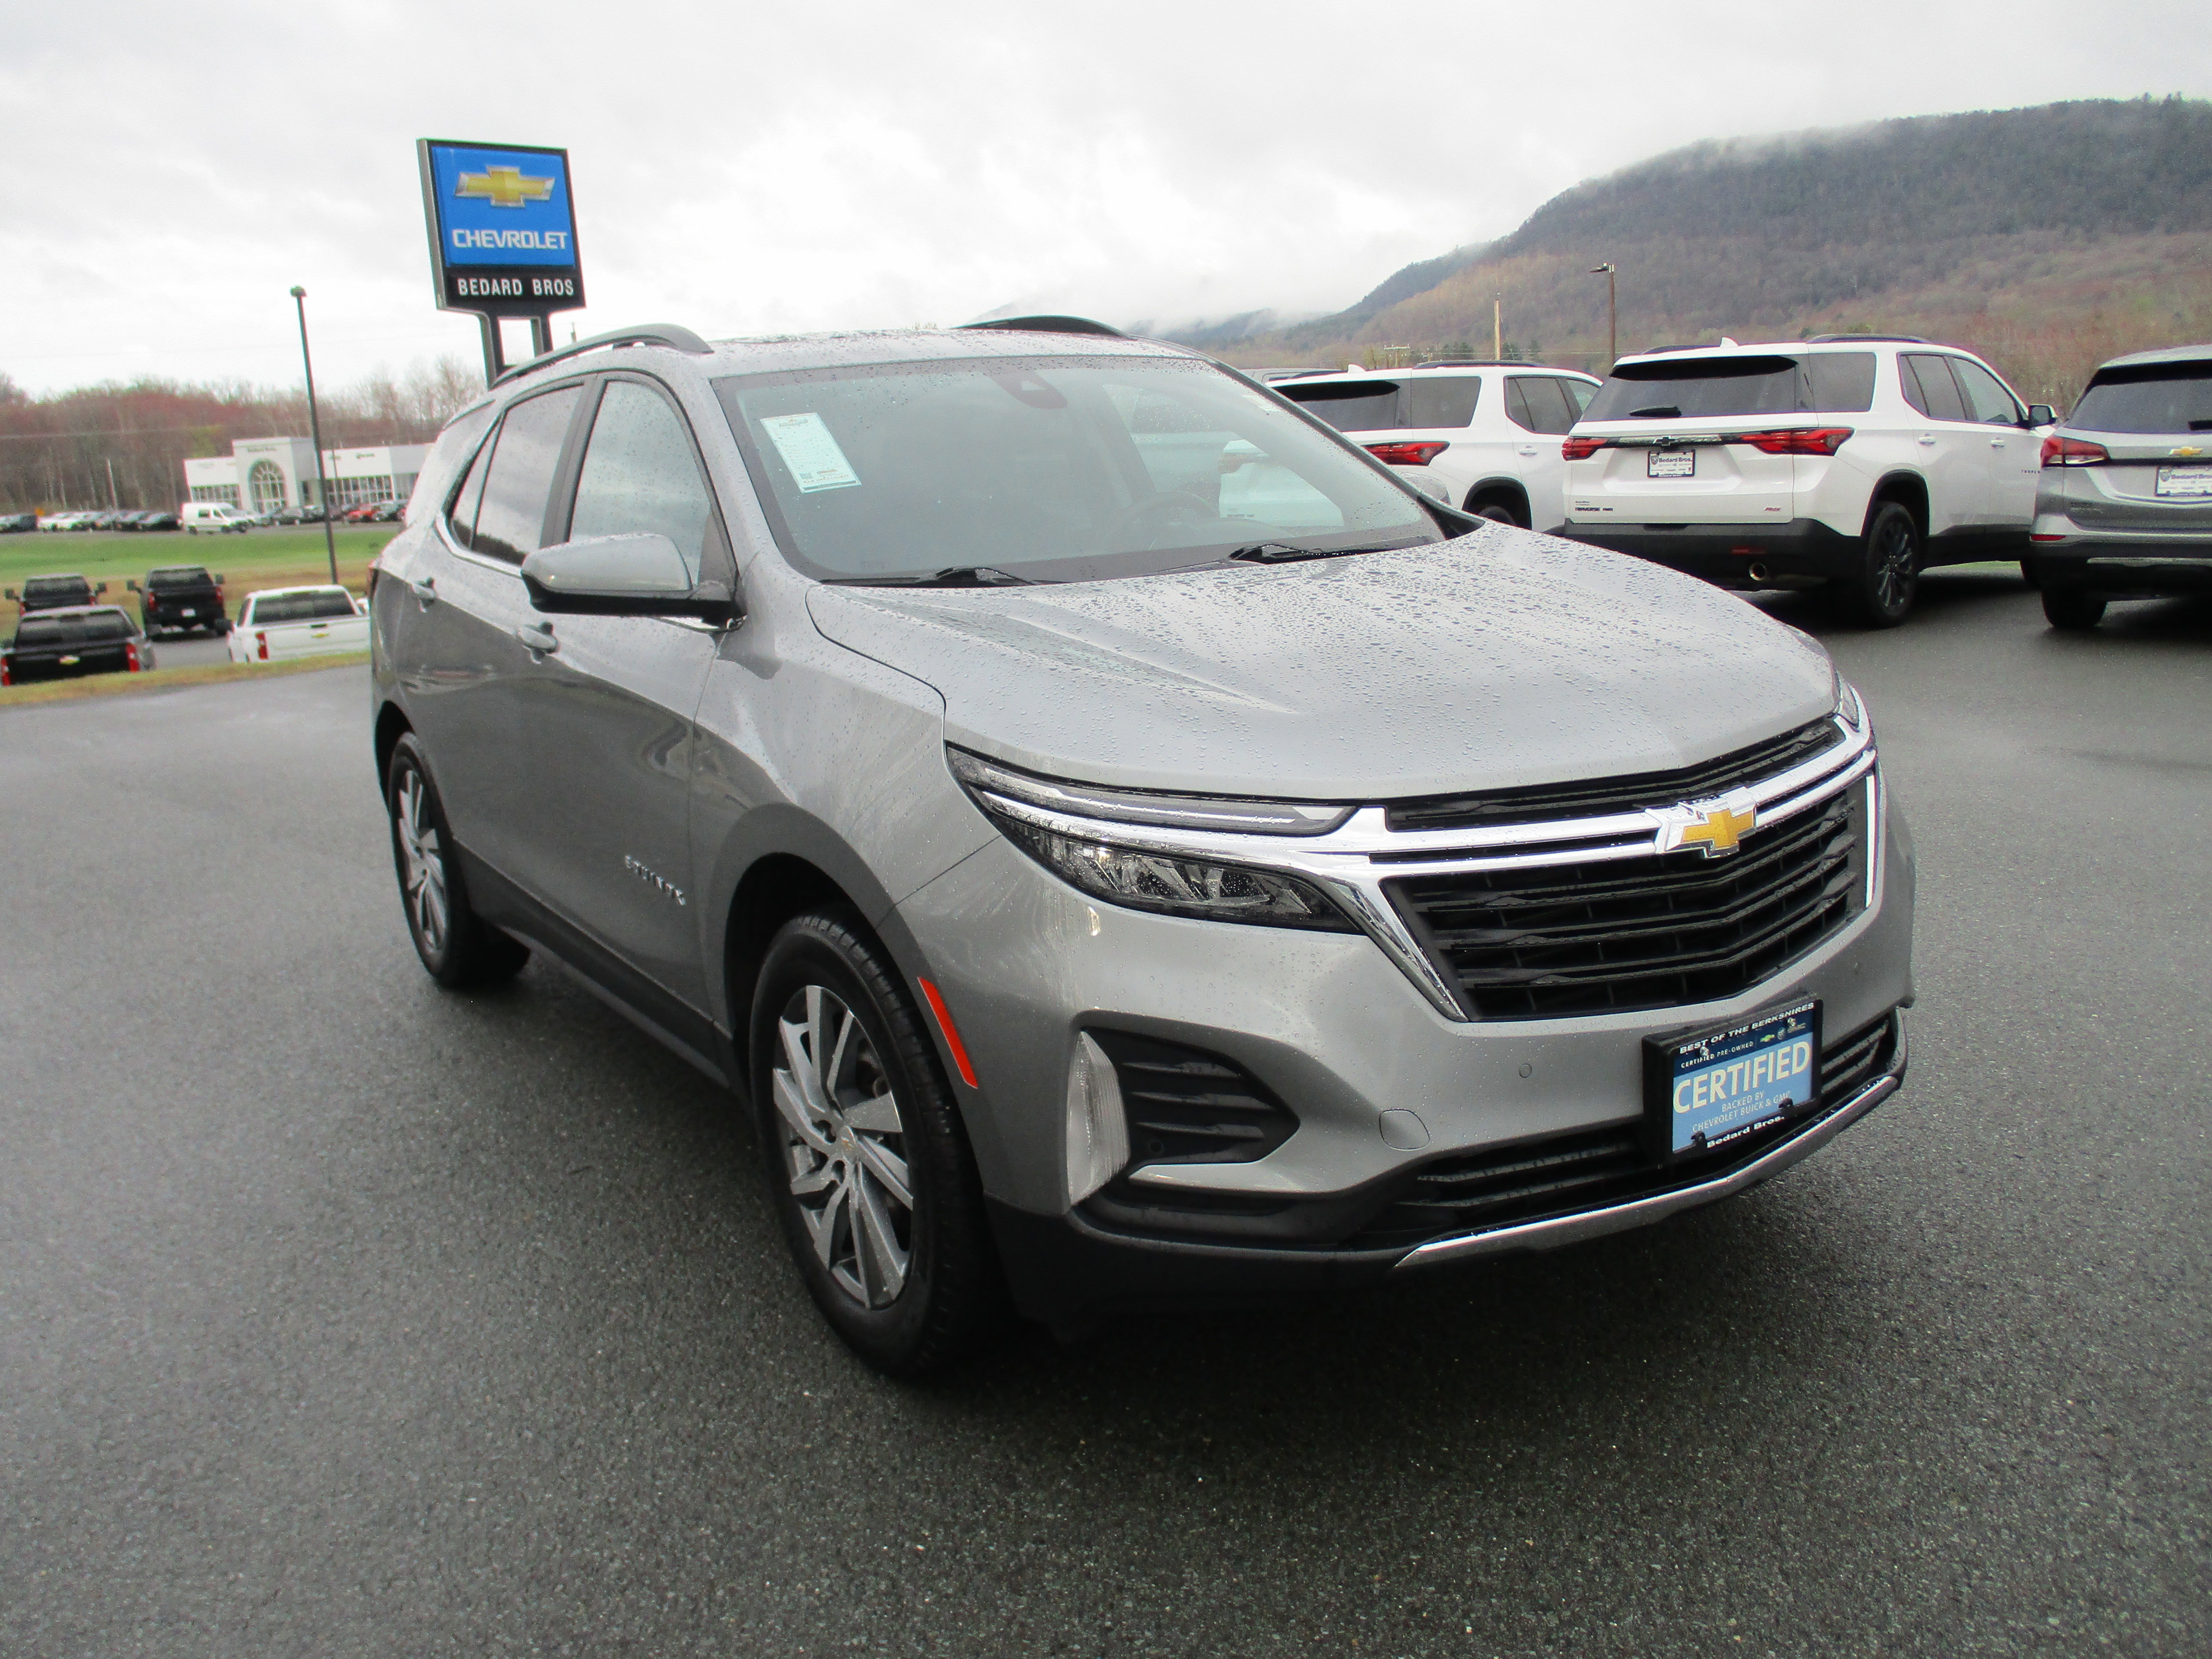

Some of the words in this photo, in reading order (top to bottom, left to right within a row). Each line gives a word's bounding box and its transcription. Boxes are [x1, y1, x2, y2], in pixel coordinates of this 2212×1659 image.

[452, 229, 568, 249] CHEVROLET
[457, 278, 523, 296] BEDARD
[532, 278, 574, 296] BROS
[1680, 1039, 1708, 1054] BEST
[1711, 1033, 1726, 1043] OF
[1728, 1025, 1749, 1037] THE
[1751, 1003, 1814, 1029] BERKSHIRES
[1681, 1053, 1714, 1068] CERTIFIED
[1717, 1041, 1753, 1057] PRE-OWNED
[1673, 1041, 1812, 1114] CERTIFIED
[1692, 1110, 1738, 1133] CHEVROLET
[1741, 1100, 1763, 1115] BUICK
[1722, 1095, 1752, 1112] BACKED
[1755, 1091, 1765, 1100] BY
[1707, 1126, 1750, 1149] Bedard
[1753, 1116, 1785, 1130] Bros.
